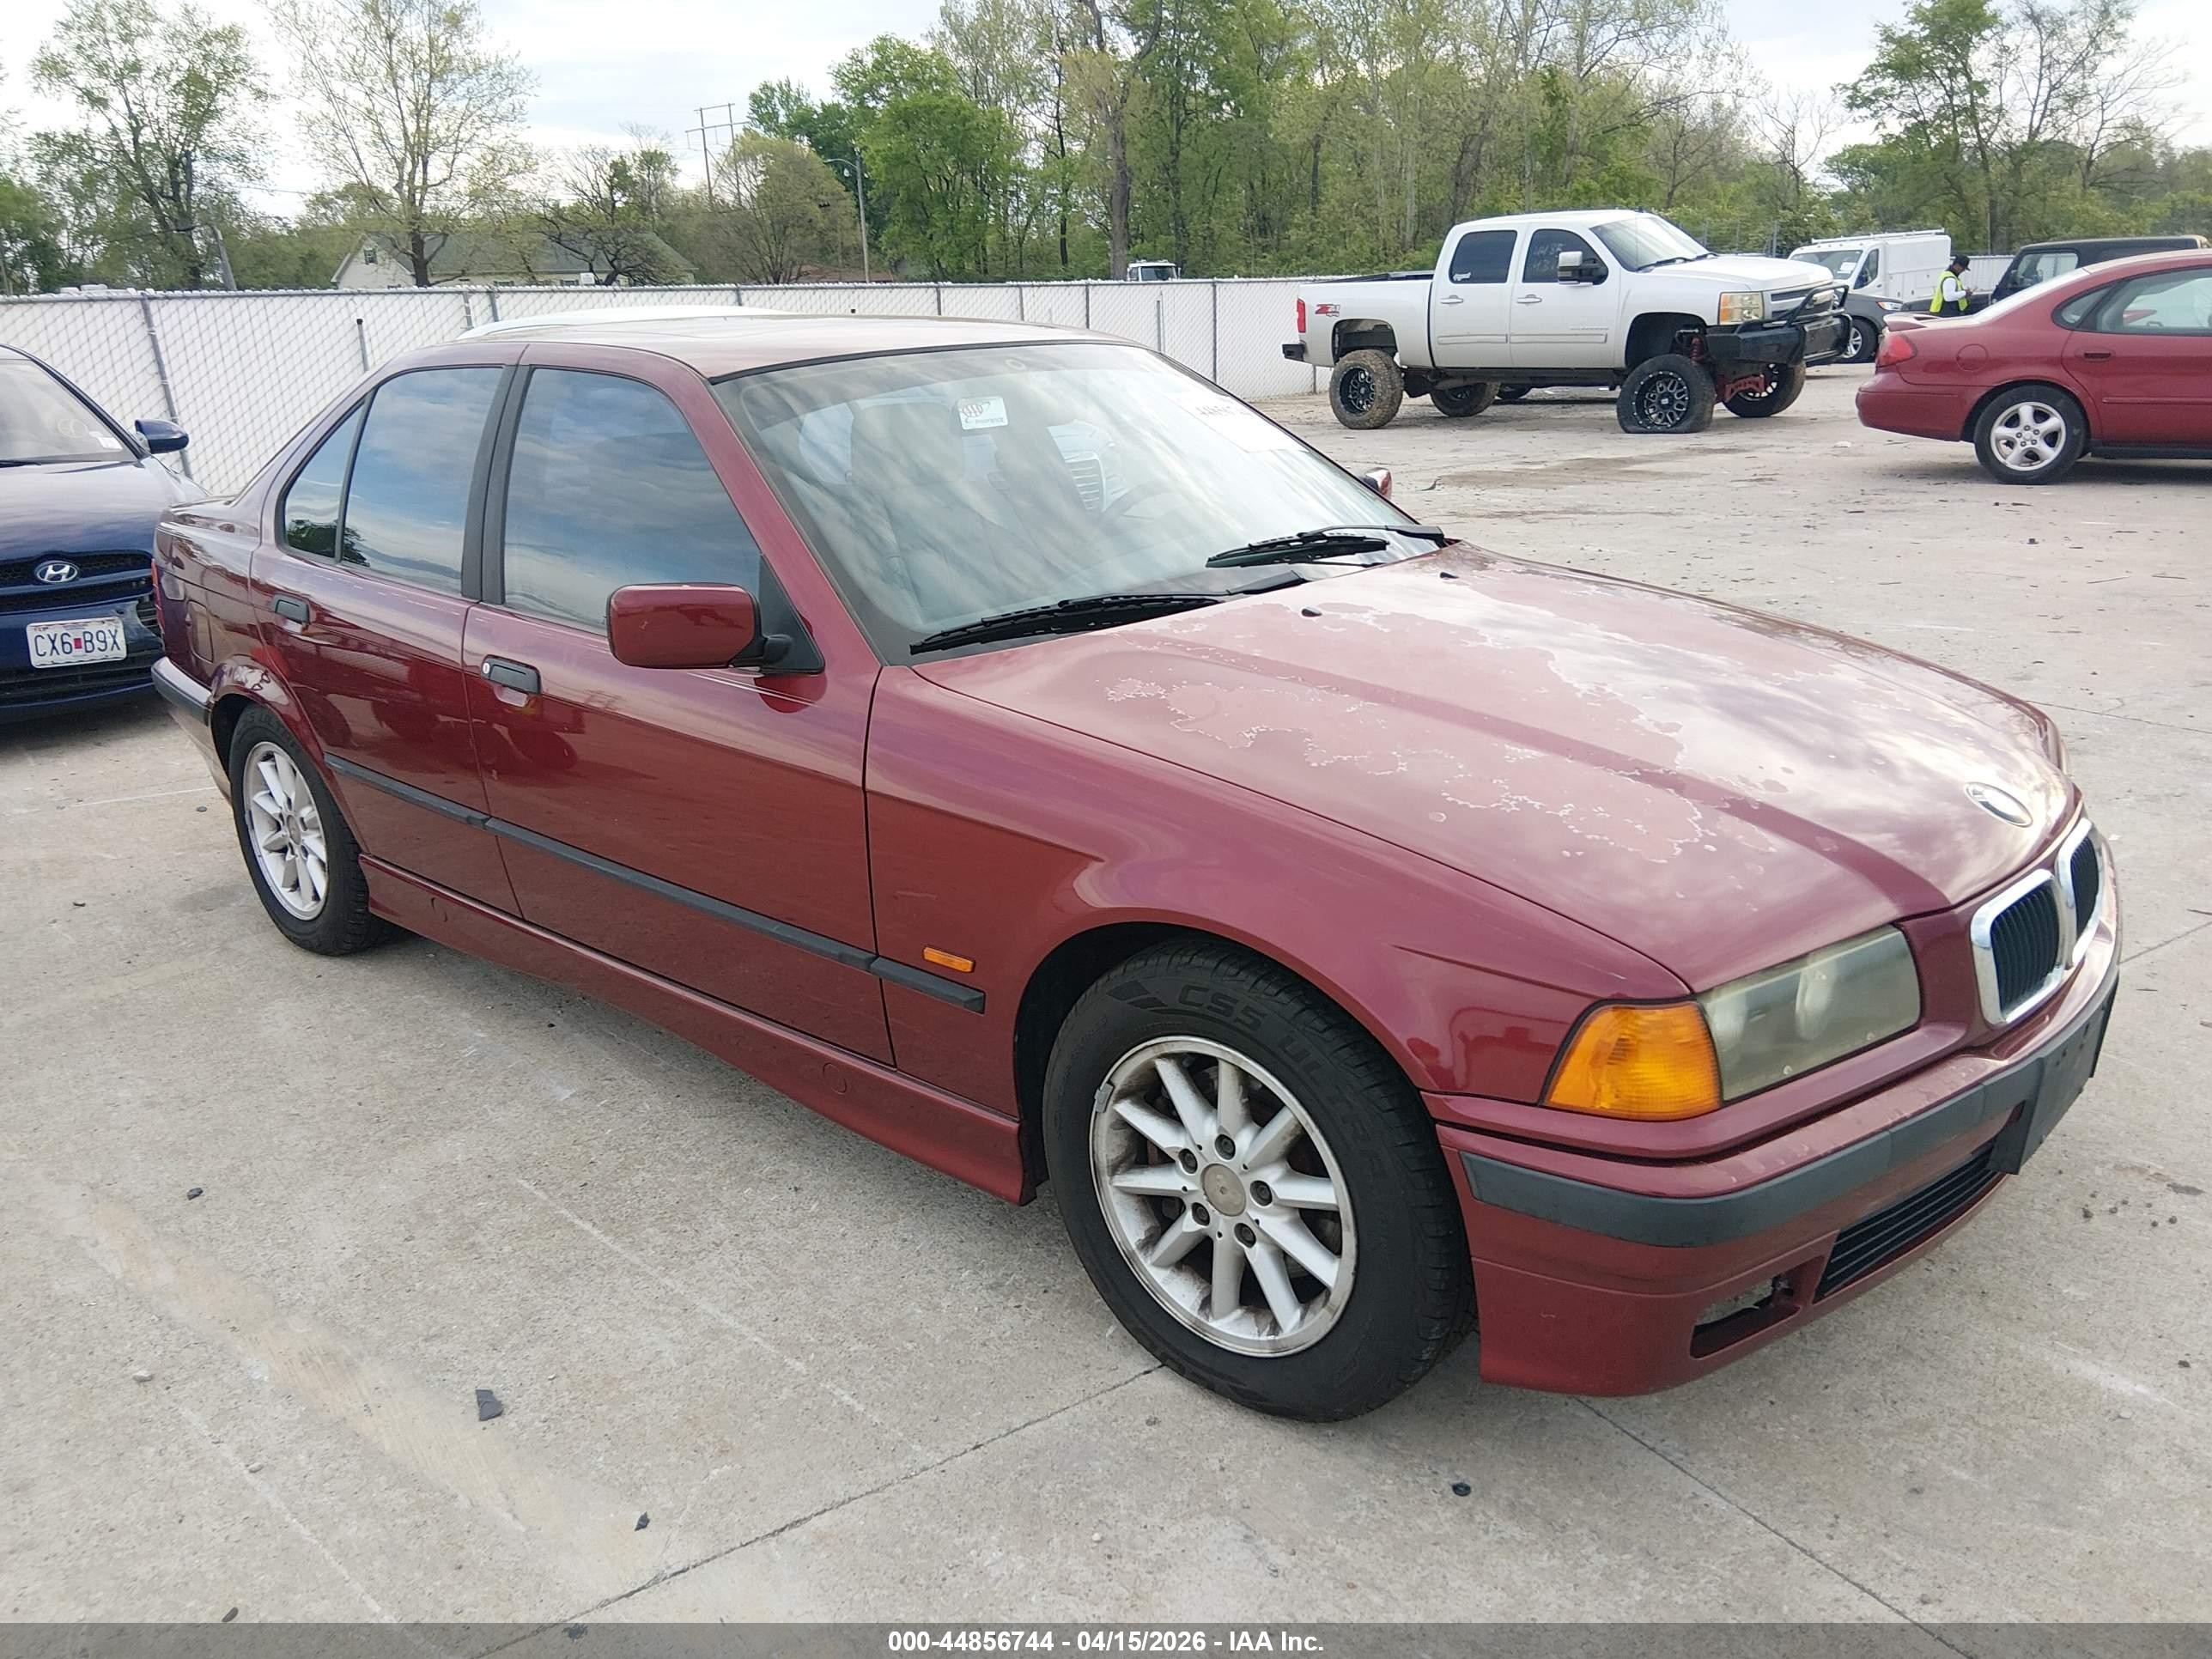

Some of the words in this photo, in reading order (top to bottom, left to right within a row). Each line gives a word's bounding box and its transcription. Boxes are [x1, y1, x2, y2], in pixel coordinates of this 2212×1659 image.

[34, 632, 73, 658] CX6
[82, 629, 120, 653] B9X
[1176, 983, 1268, 1032] CS5
